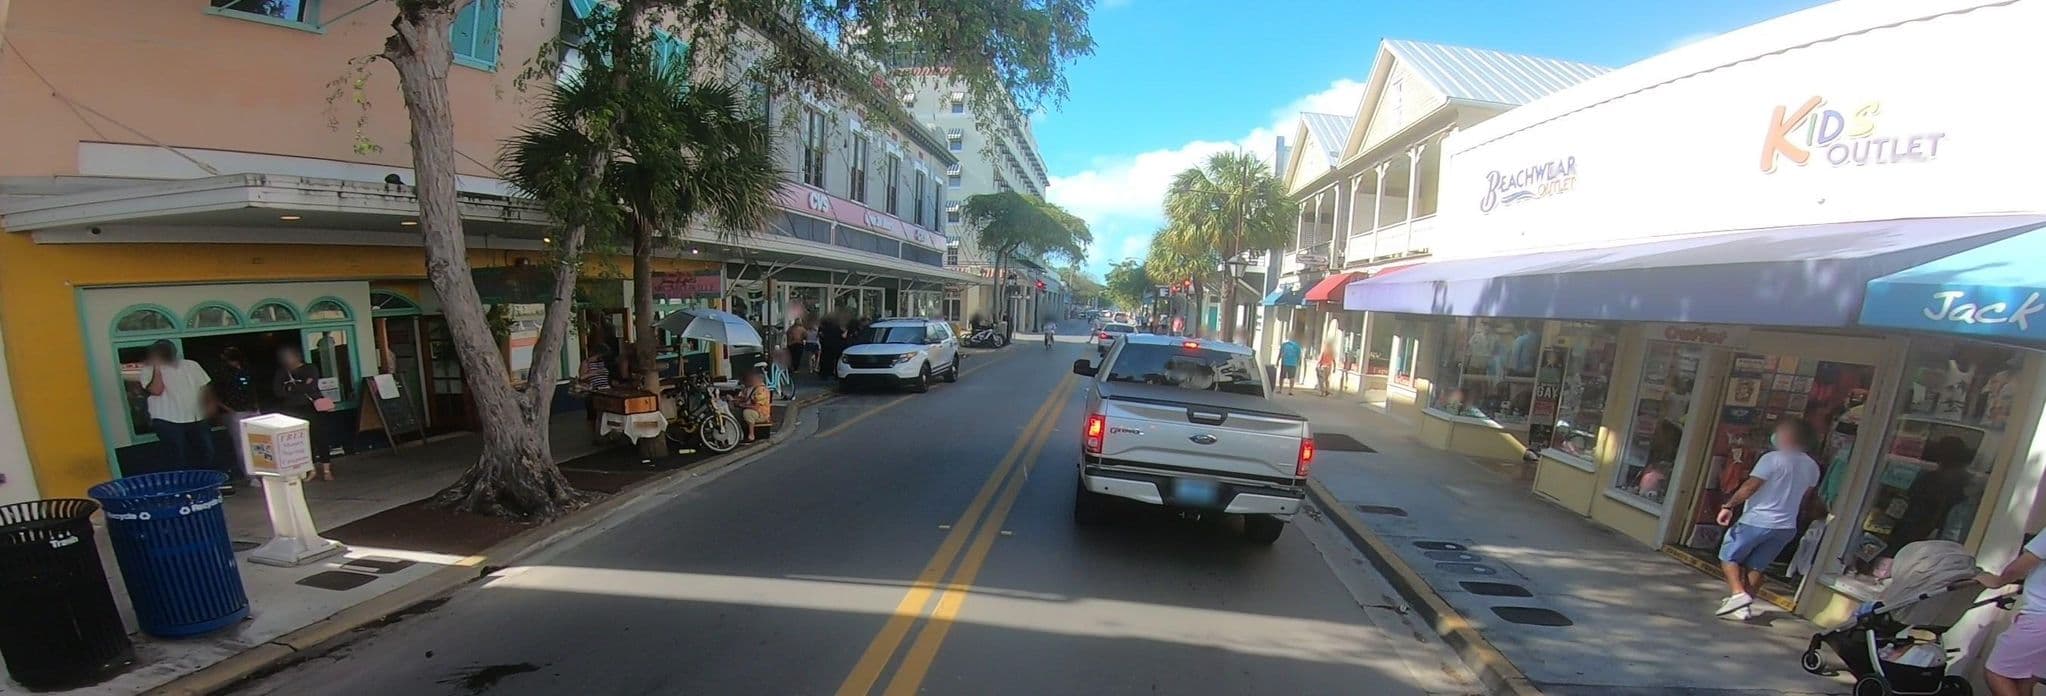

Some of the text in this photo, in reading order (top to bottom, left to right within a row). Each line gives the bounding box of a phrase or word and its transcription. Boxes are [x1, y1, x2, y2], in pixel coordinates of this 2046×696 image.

[1759, 95, 1880, 173] KIDS
[1826, 132, 1946, 166] OUTLET
[808, 191, 829, 213] CVS
[1480, 156, 1576, 215] BEACHWEAR
[1537, 176, 1576, 197] OUTLET
[1923, 290, 2045, 331] Jack
[1536, 385, 1559, 400] GAY
